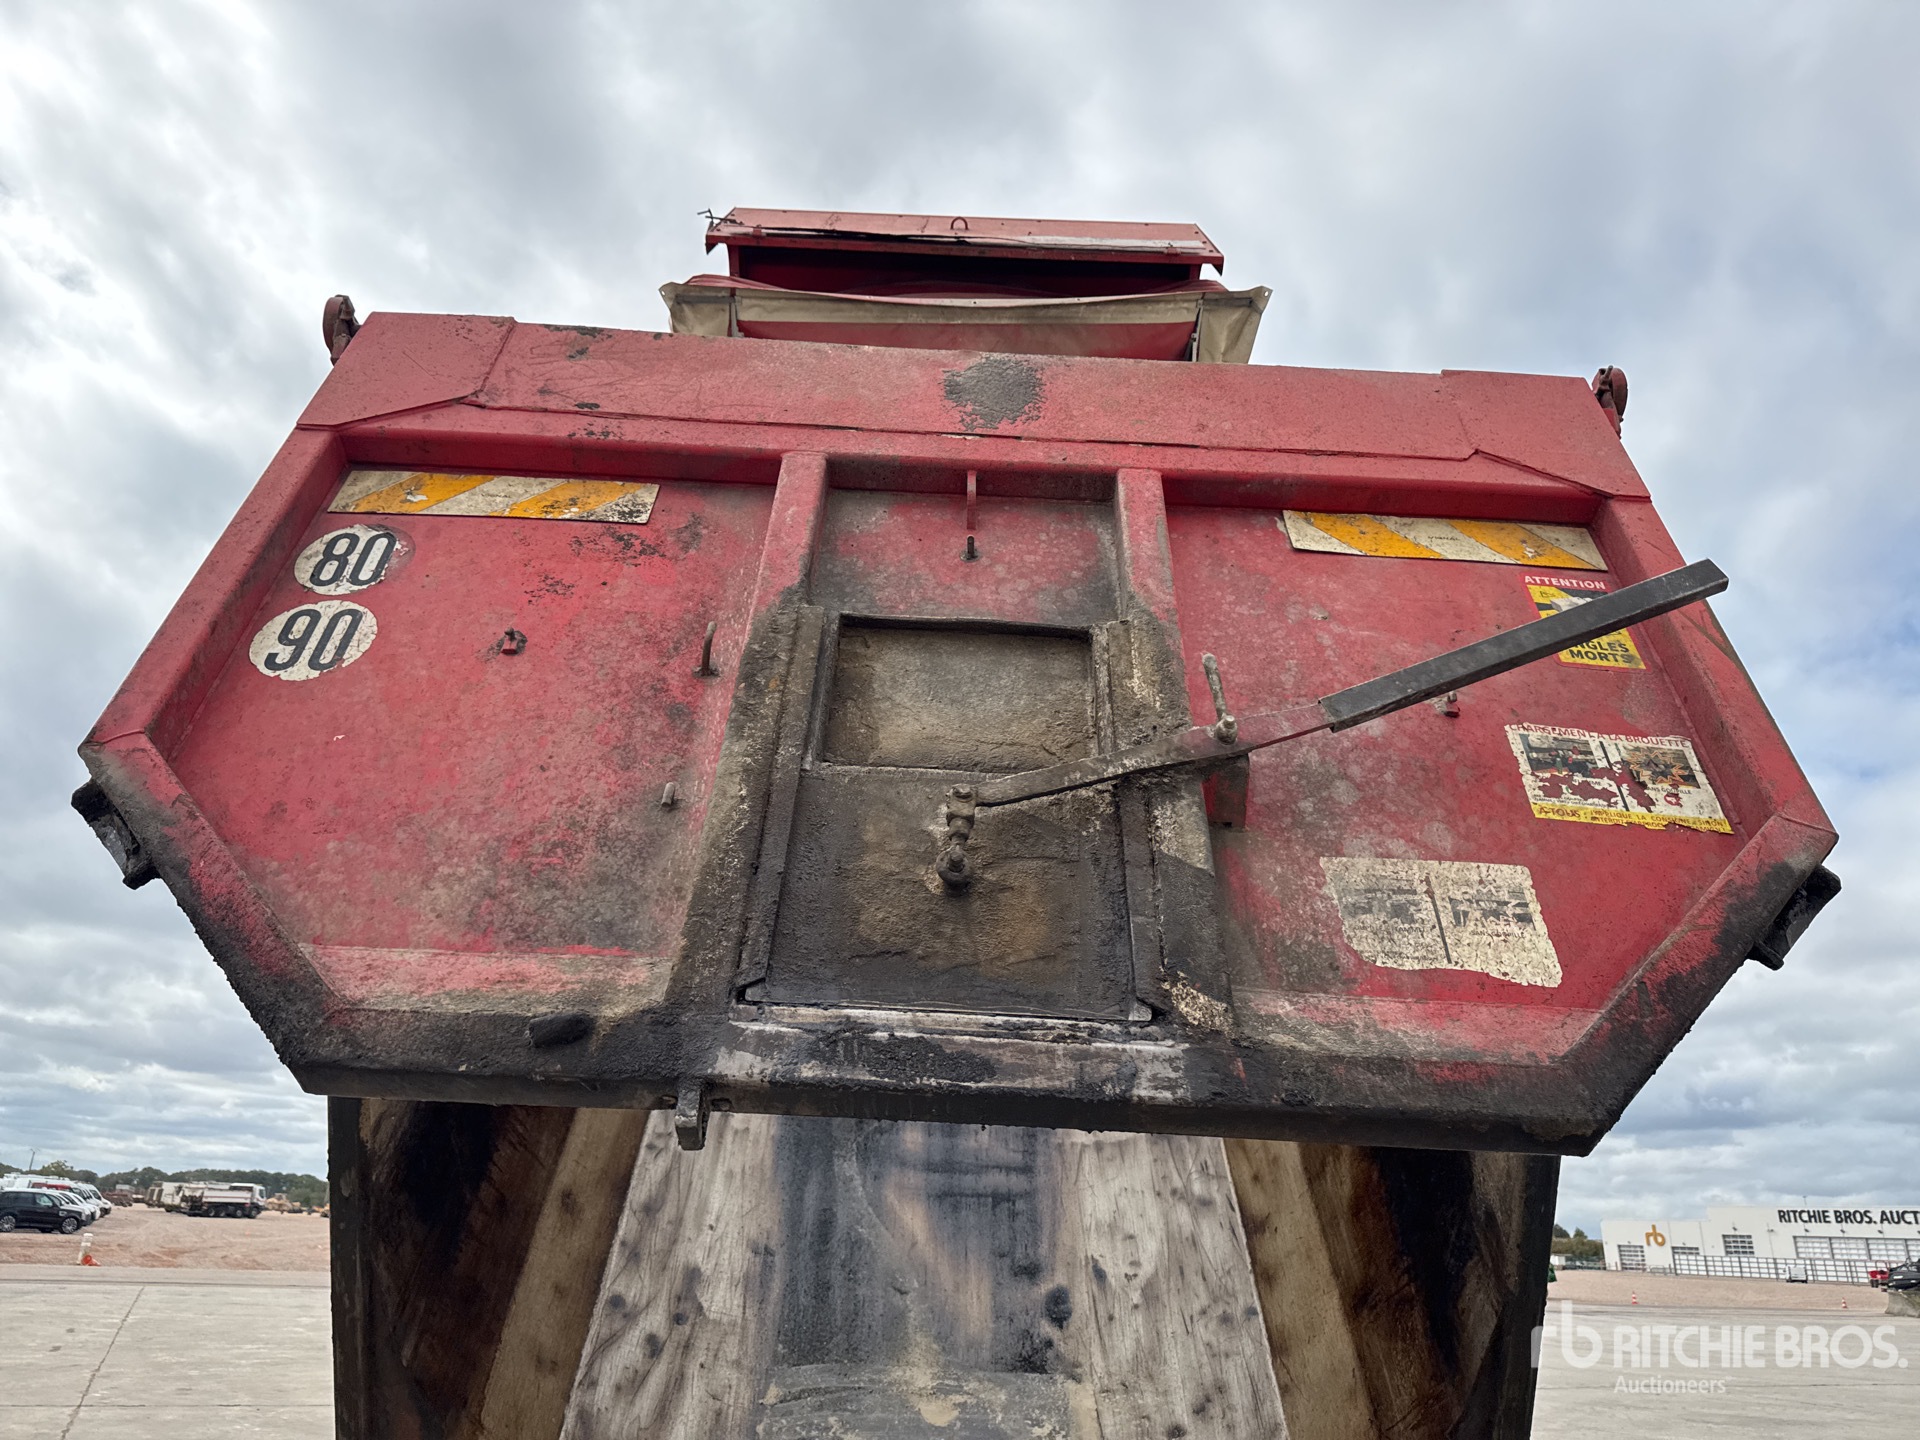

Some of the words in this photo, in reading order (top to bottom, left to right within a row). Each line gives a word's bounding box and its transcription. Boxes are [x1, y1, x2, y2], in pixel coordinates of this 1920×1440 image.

[309, 532, 397, 587] 80
[1524, 575, 1606, 590] ATTENTION
[263, 608, 363, 671] 90
[1573, 640, 1630, 653] NGLES
[1568, 649, 1634, 664] MORTS
[1510, 725, 1594, 739] CHARGEMEN
[1777, 1209, 1832, 1224] RITCHIE
[1834, 1210, 1878, 1225] BROS.
[1880, 1210, 1920, 1225] AUCT
